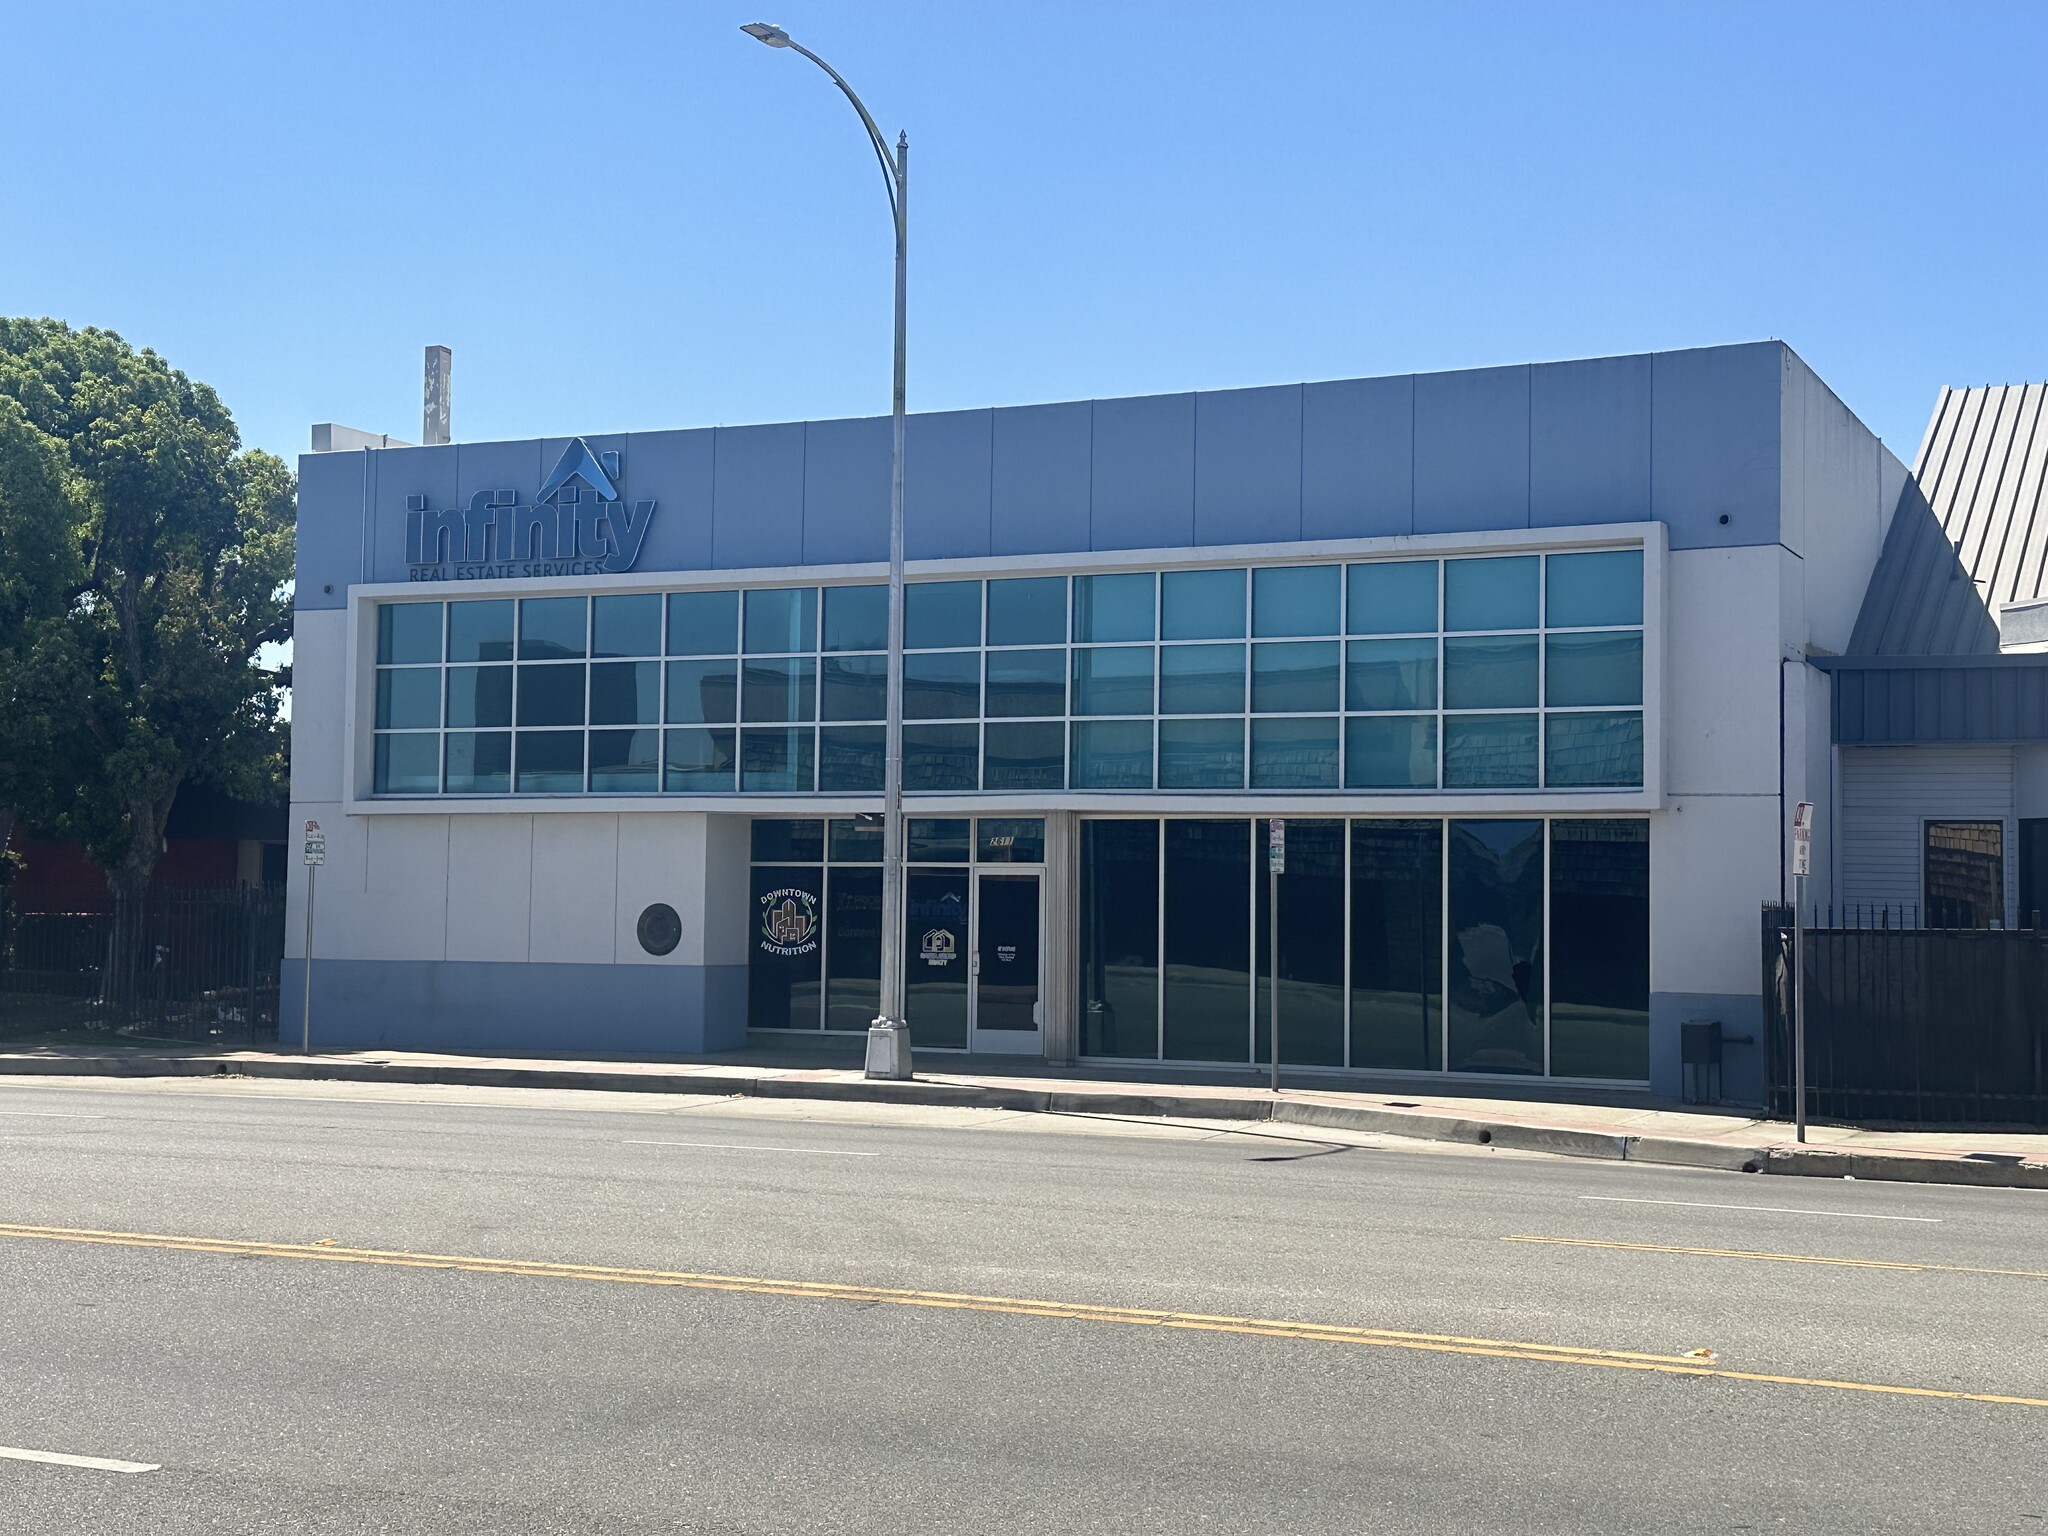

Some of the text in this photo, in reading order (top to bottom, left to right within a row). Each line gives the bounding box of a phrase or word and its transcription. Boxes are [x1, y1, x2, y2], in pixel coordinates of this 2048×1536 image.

[404, 485, 656, 572] infinity
[410, 560, 603, 583] REAL ESTATE SERVICES
[760, 888, 817, 905] DOWNTOWN
[760, 940, 817, 956] NUTRITION
